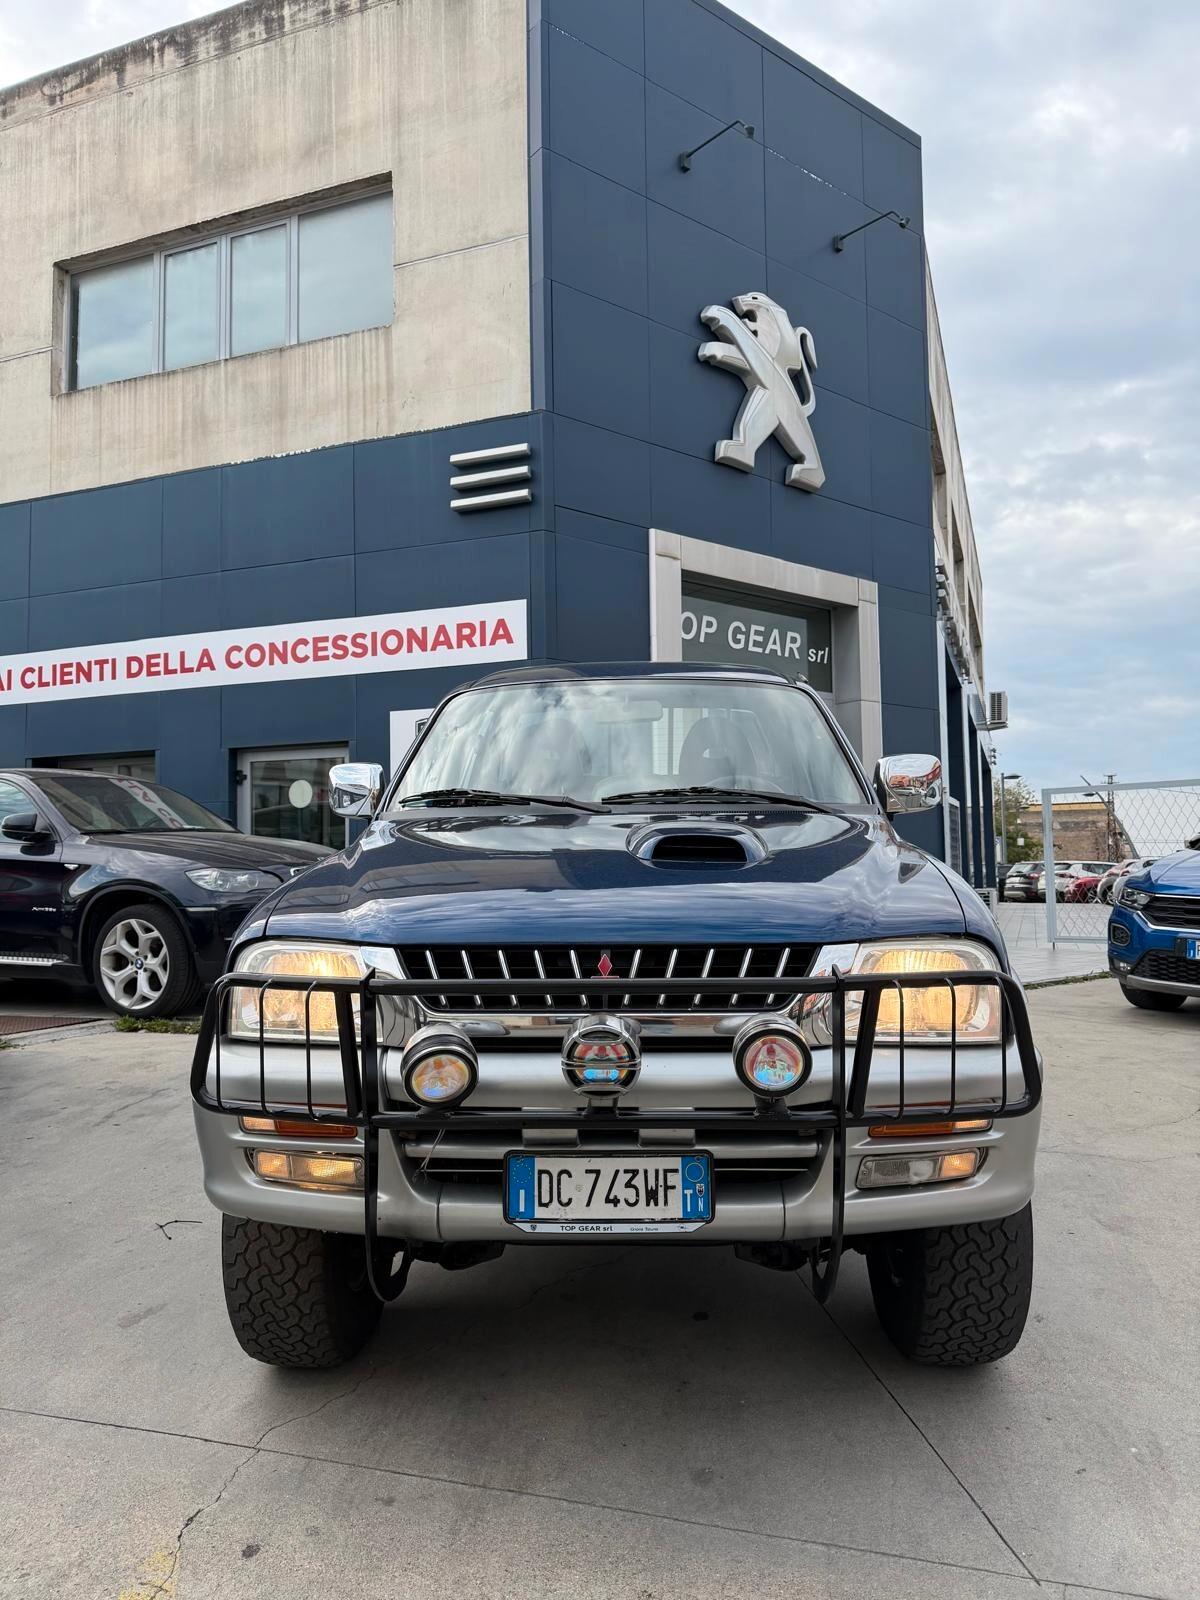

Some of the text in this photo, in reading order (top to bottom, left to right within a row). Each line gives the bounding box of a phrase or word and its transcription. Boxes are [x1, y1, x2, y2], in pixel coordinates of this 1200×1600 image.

[0, 618, 514, 692] I CLIENTI DELLA CONCESSIONARIA
[681, 611, 829, 664] OP GEAR srl
[537, 1169, 573, 1208] DC
[584, 1169, 680, 1208] 743WF
